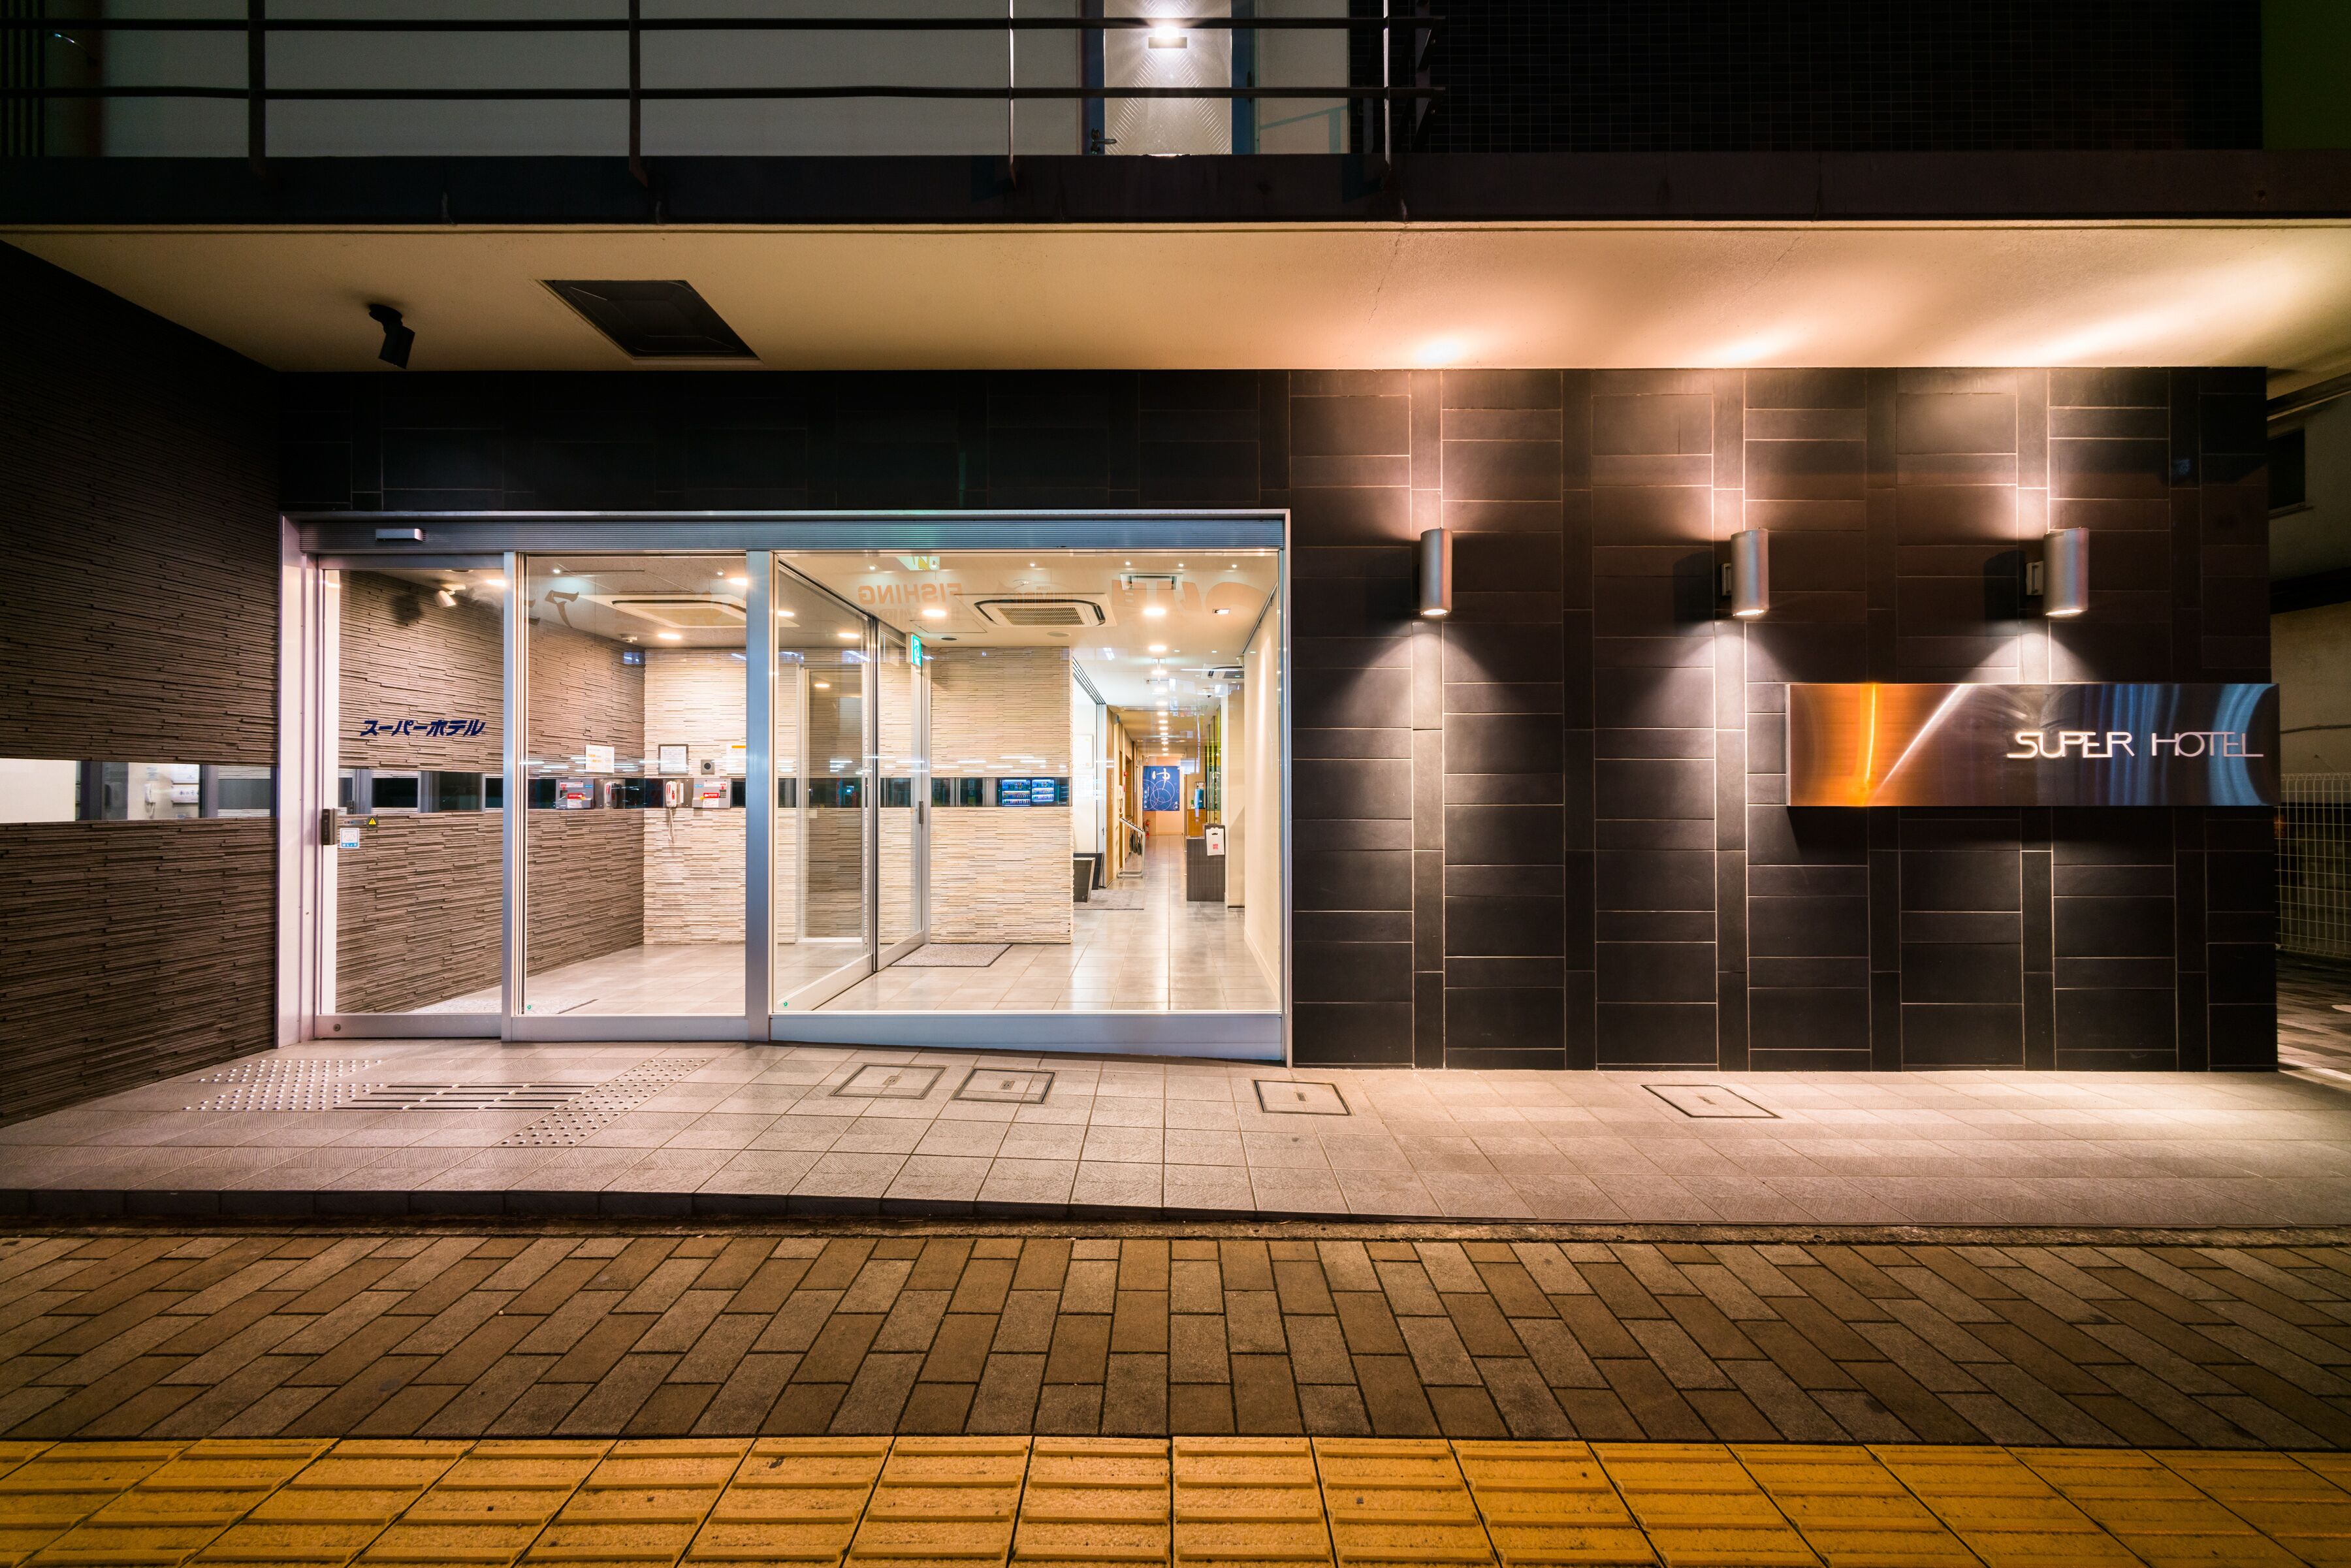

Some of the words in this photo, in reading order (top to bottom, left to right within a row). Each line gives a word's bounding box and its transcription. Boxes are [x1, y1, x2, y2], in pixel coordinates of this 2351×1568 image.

[360, 720, 486, 737] スーパーホテル
[2007, 731, 2135, 759] SUPER
[2151, 731, 2264, 758] HOTEL
[1152, 767, 1170, 790] ゆ
